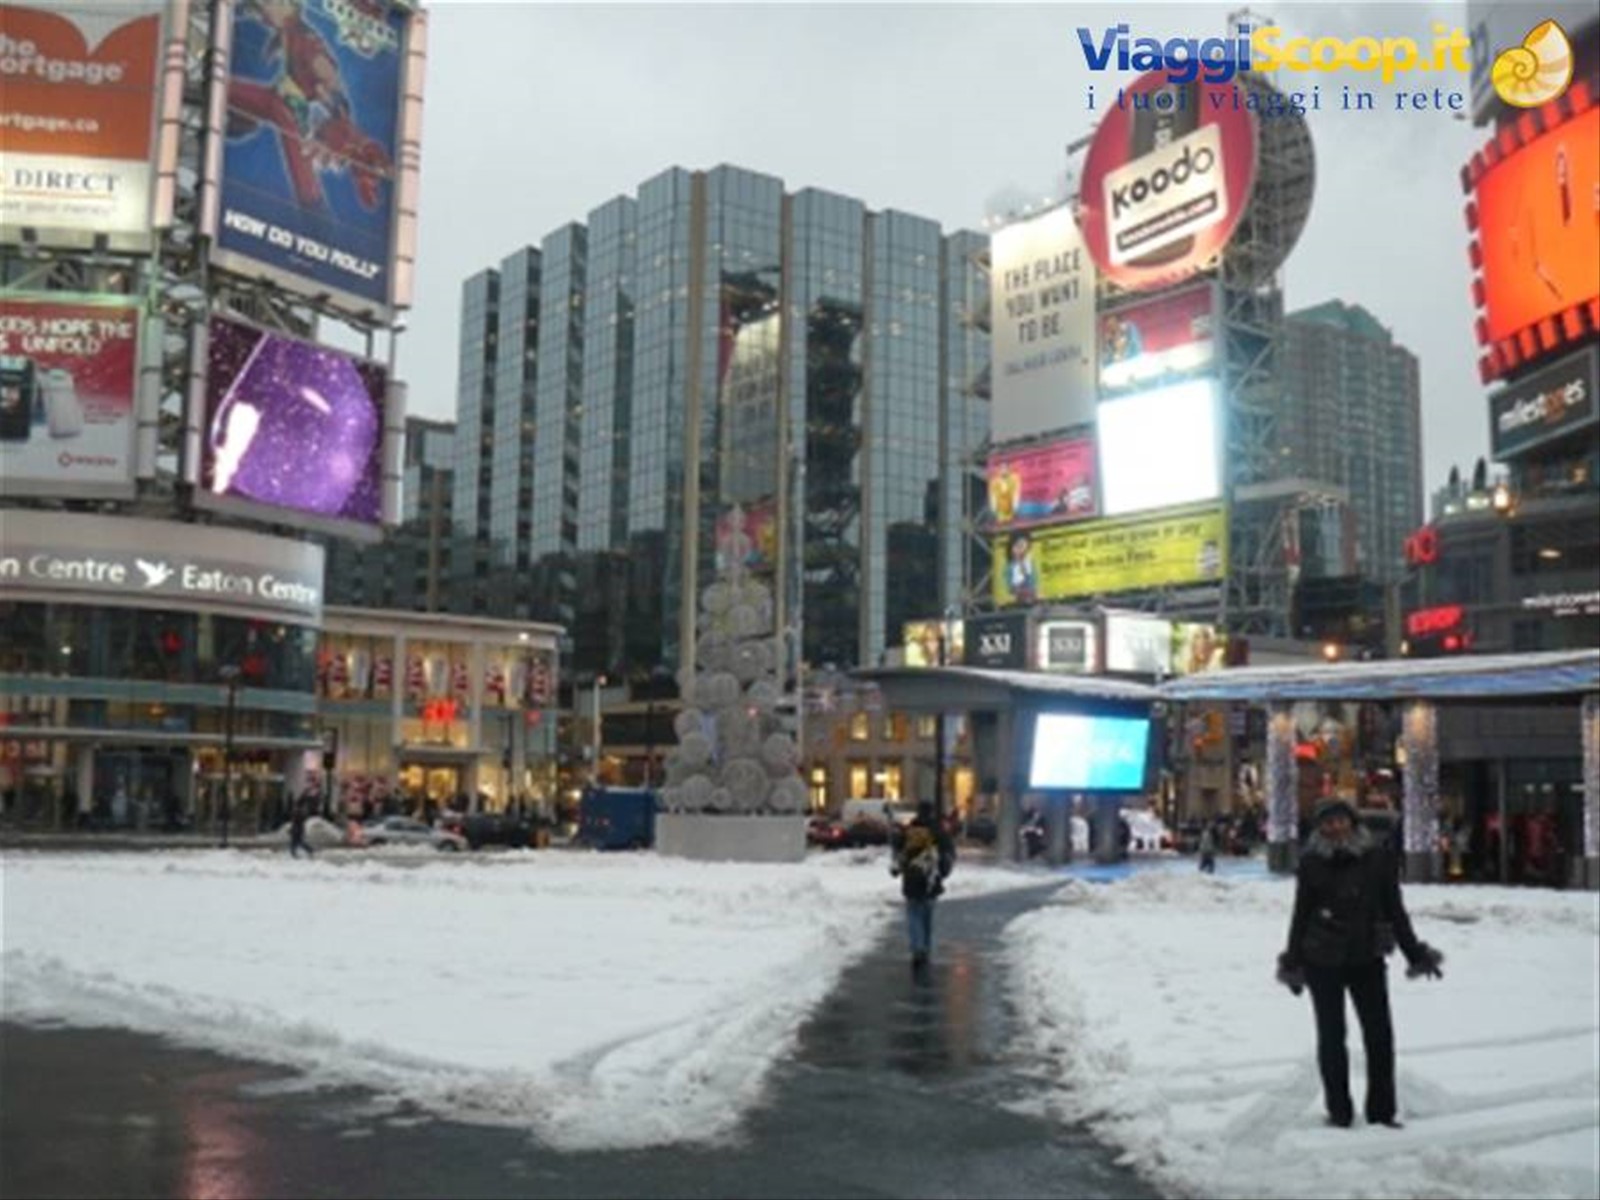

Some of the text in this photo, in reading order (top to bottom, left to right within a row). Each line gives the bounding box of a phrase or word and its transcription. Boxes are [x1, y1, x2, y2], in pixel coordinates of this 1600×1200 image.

[14, 168, 120, 193] DIRECT
[223, 208, 267, 239] HOW
[267, 225, 294, 250] DO
[296, 235, 329, 262] YOU
[1004, 247, 1081, 292] THE PLACE
[22, 333, 102, 355] UNFOLD
[28, 554, 127, 584] Centre
[181, 564, 253, 596] Eaton
